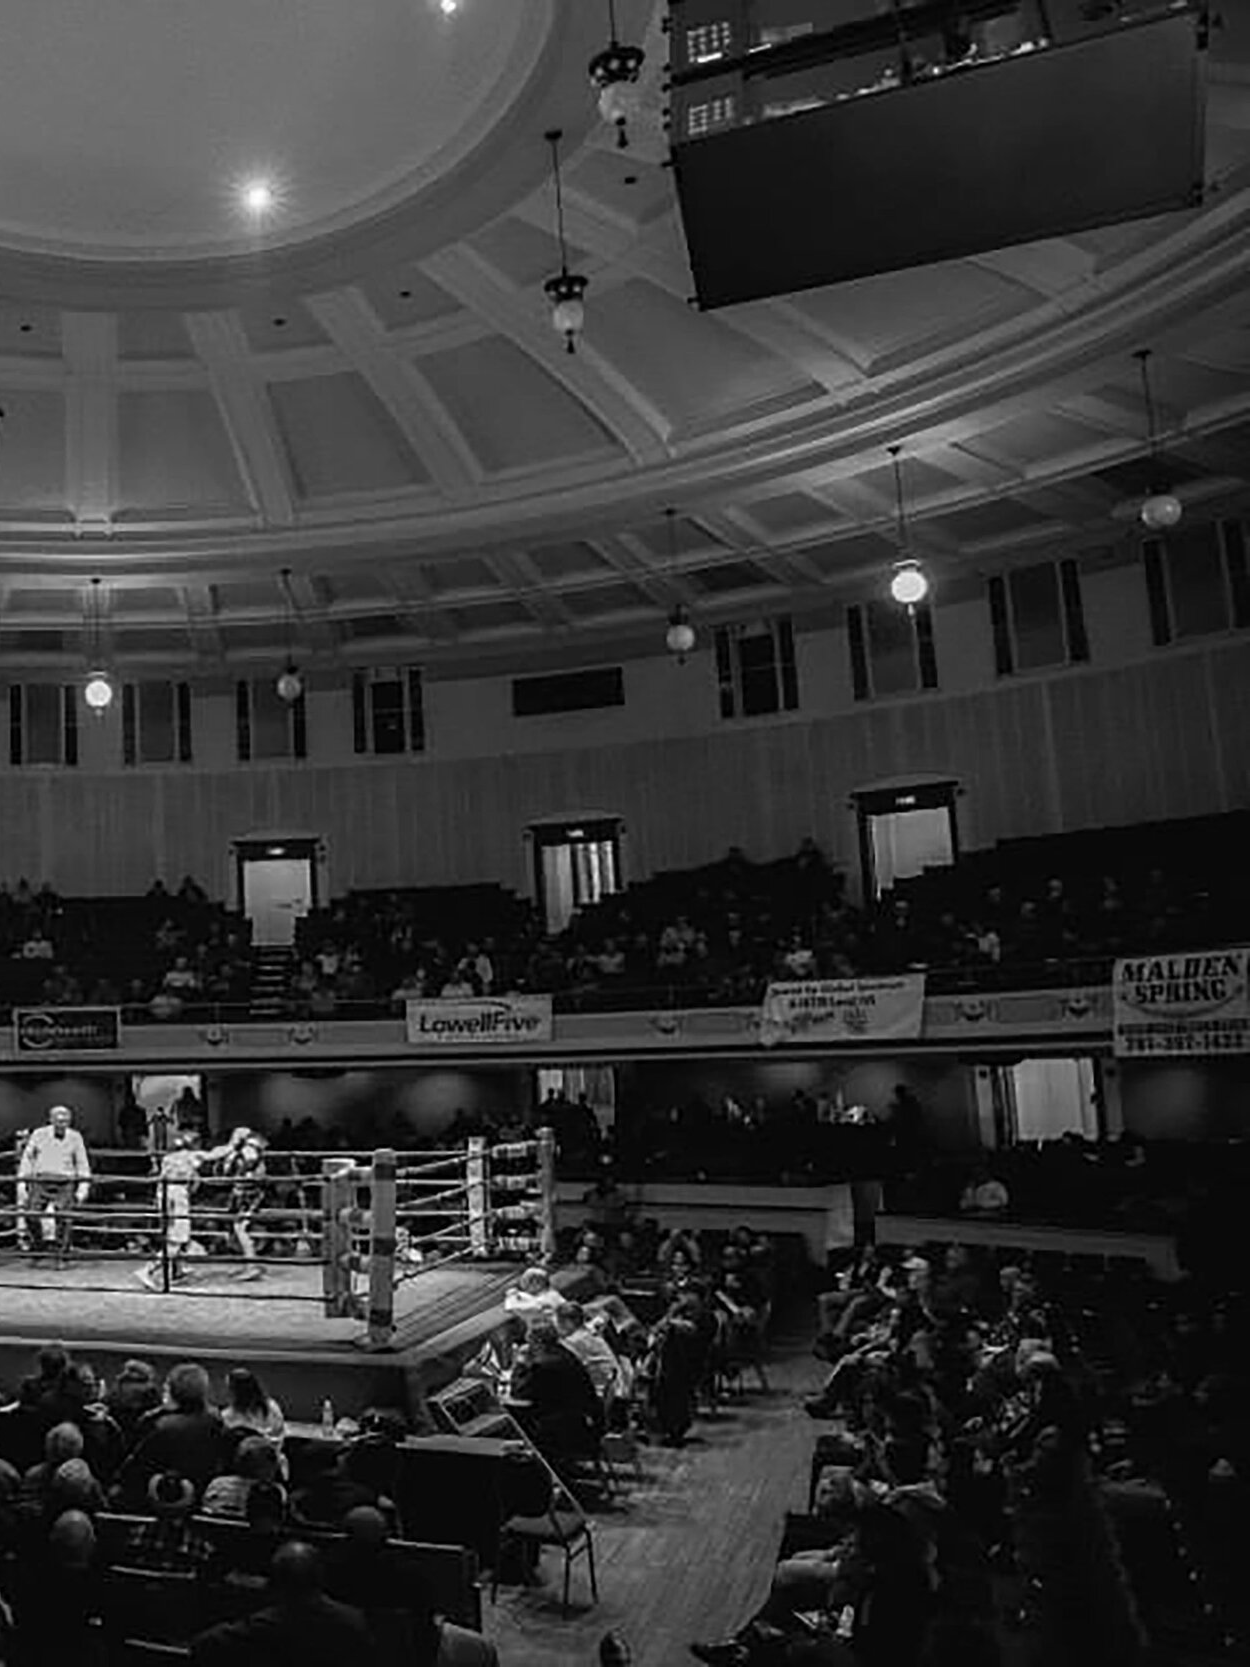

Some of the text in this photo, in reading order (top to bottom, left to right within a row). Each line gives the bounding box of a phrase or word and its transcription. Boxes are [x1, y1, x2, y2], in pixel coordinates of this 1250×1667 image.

[1122, 957, 1238, 982] MALDEN
[1136, 979, 1226, 1004] SPRING
[419, 1012, 541, 1033] LowellFive
